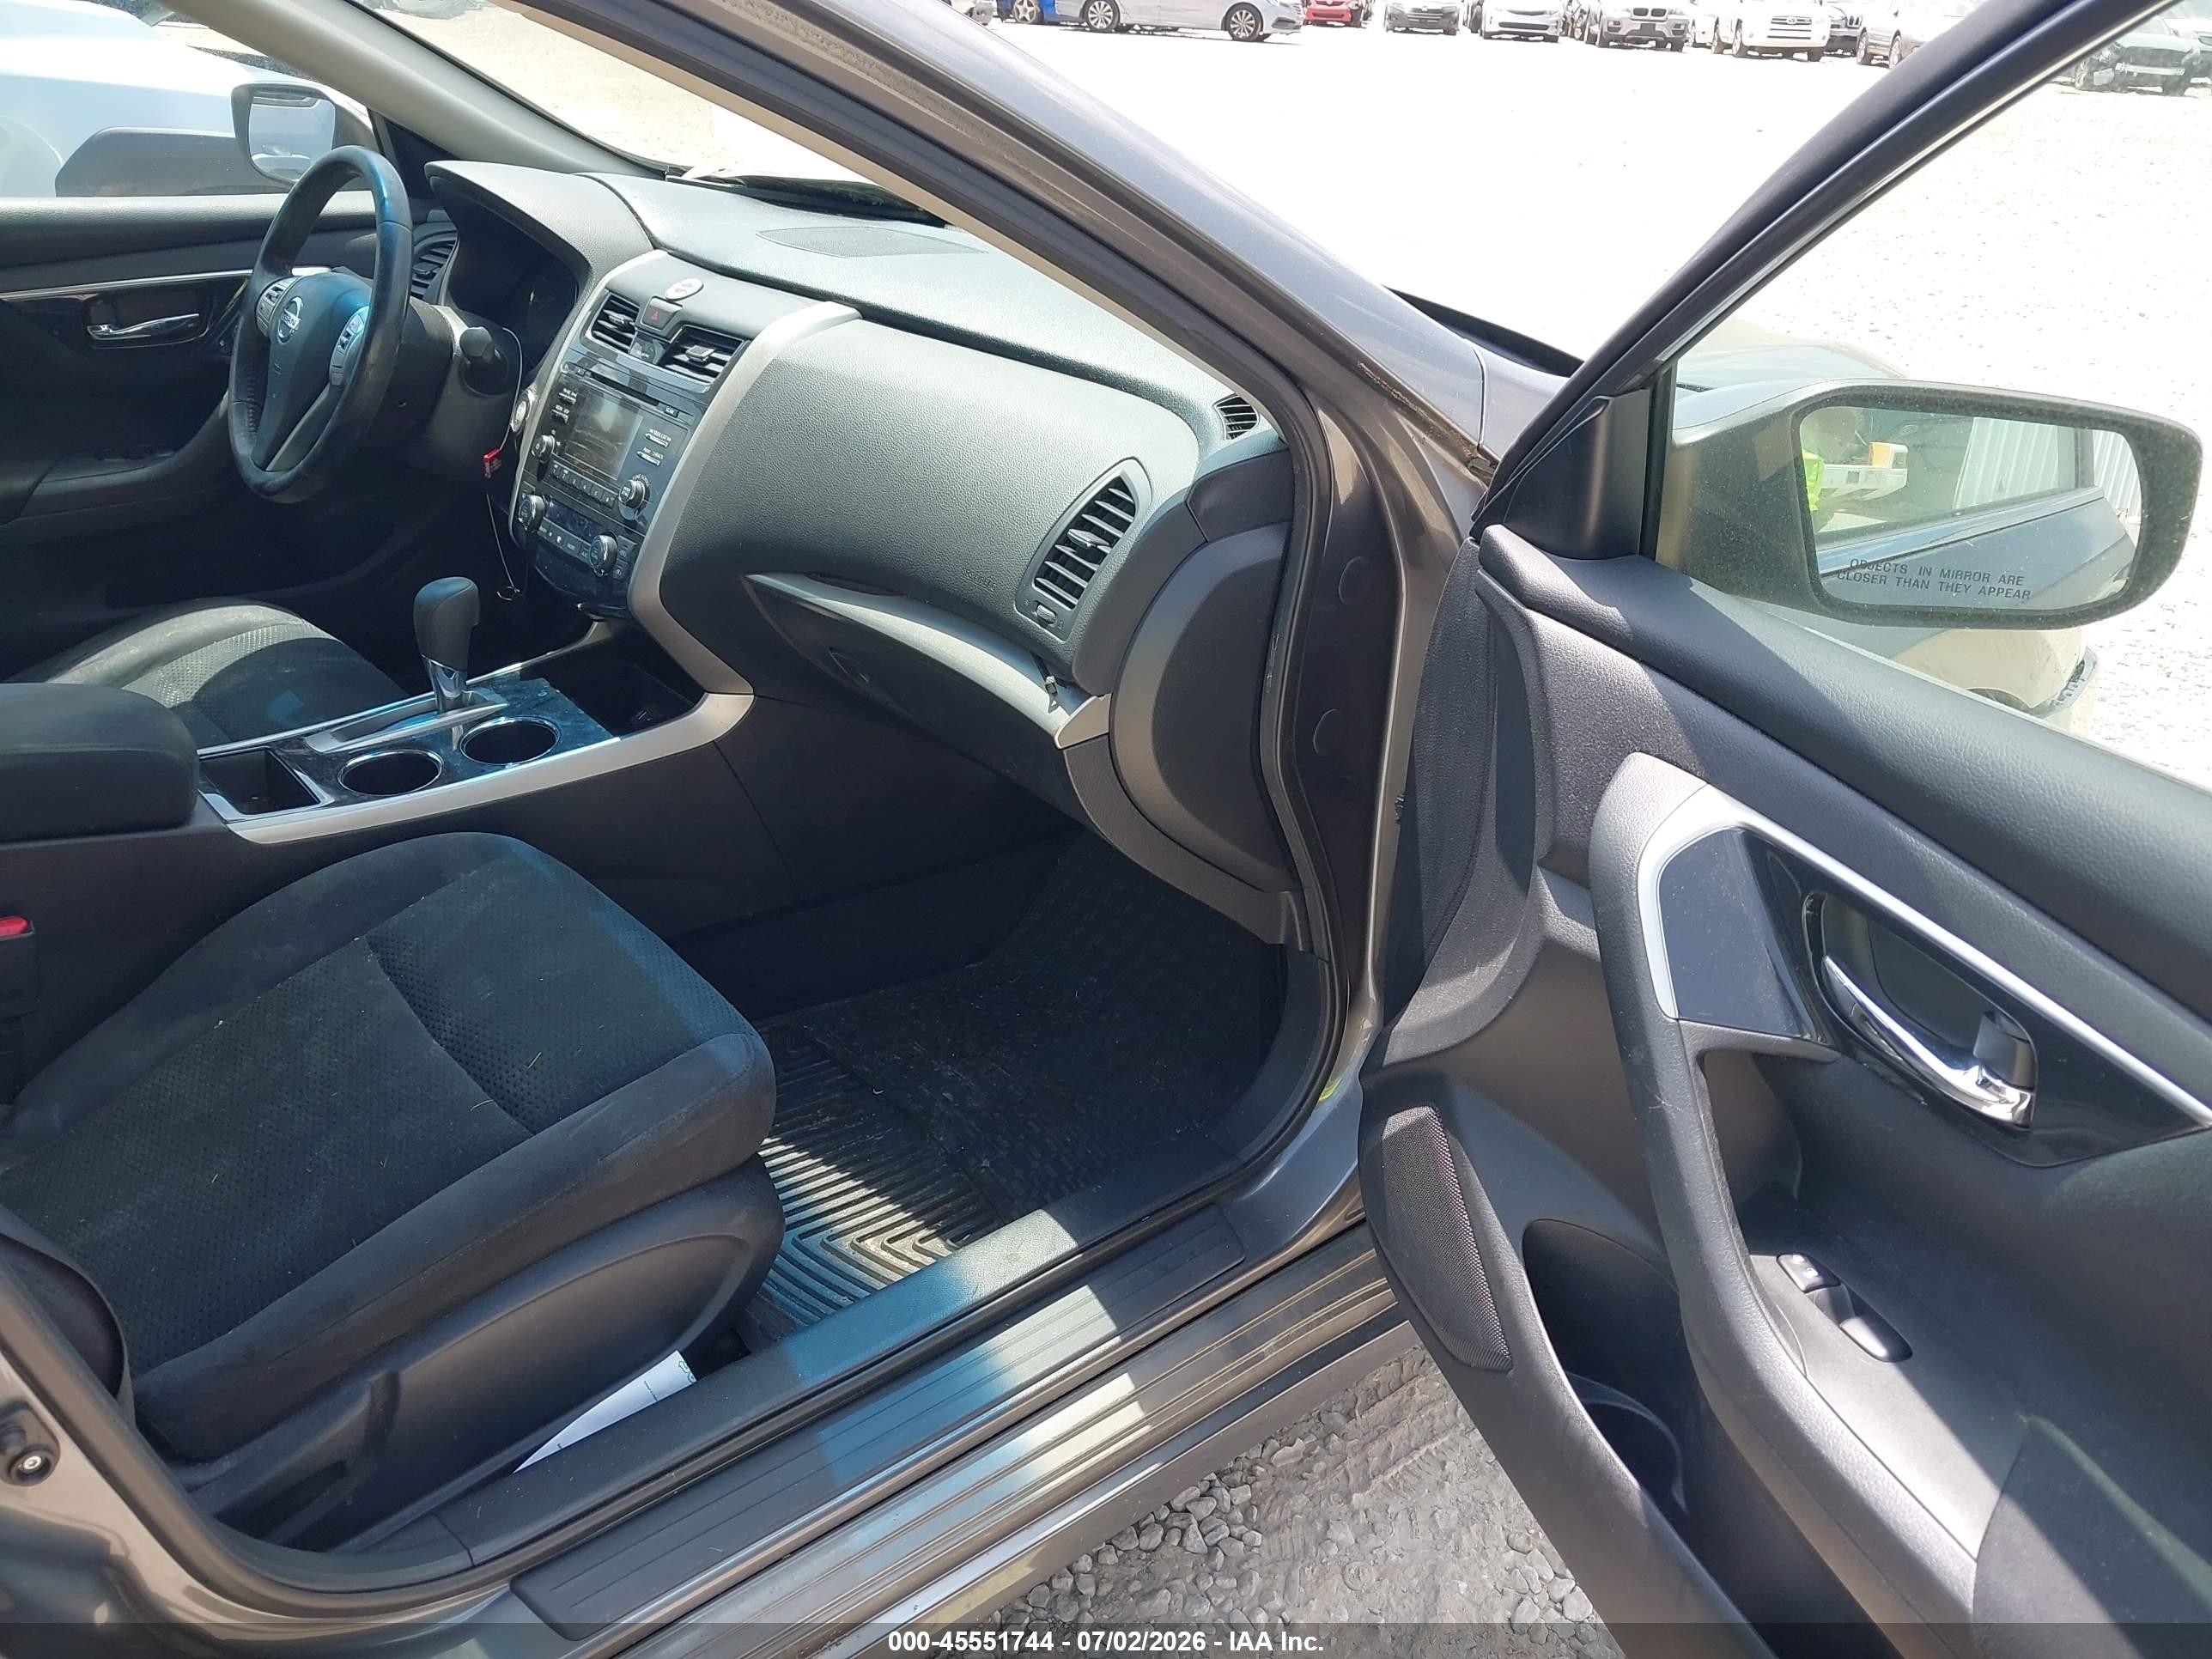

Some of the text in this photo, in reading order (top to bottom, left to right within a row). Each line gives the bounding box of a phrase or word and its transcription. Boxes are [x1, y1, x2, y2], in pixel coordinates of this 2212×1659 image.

[1837, 572, 2032, 600] CLOSER THAN THEY APPEAR
[1850, 558, 2025, 586] OBJECTS IN MIRROR ARE
